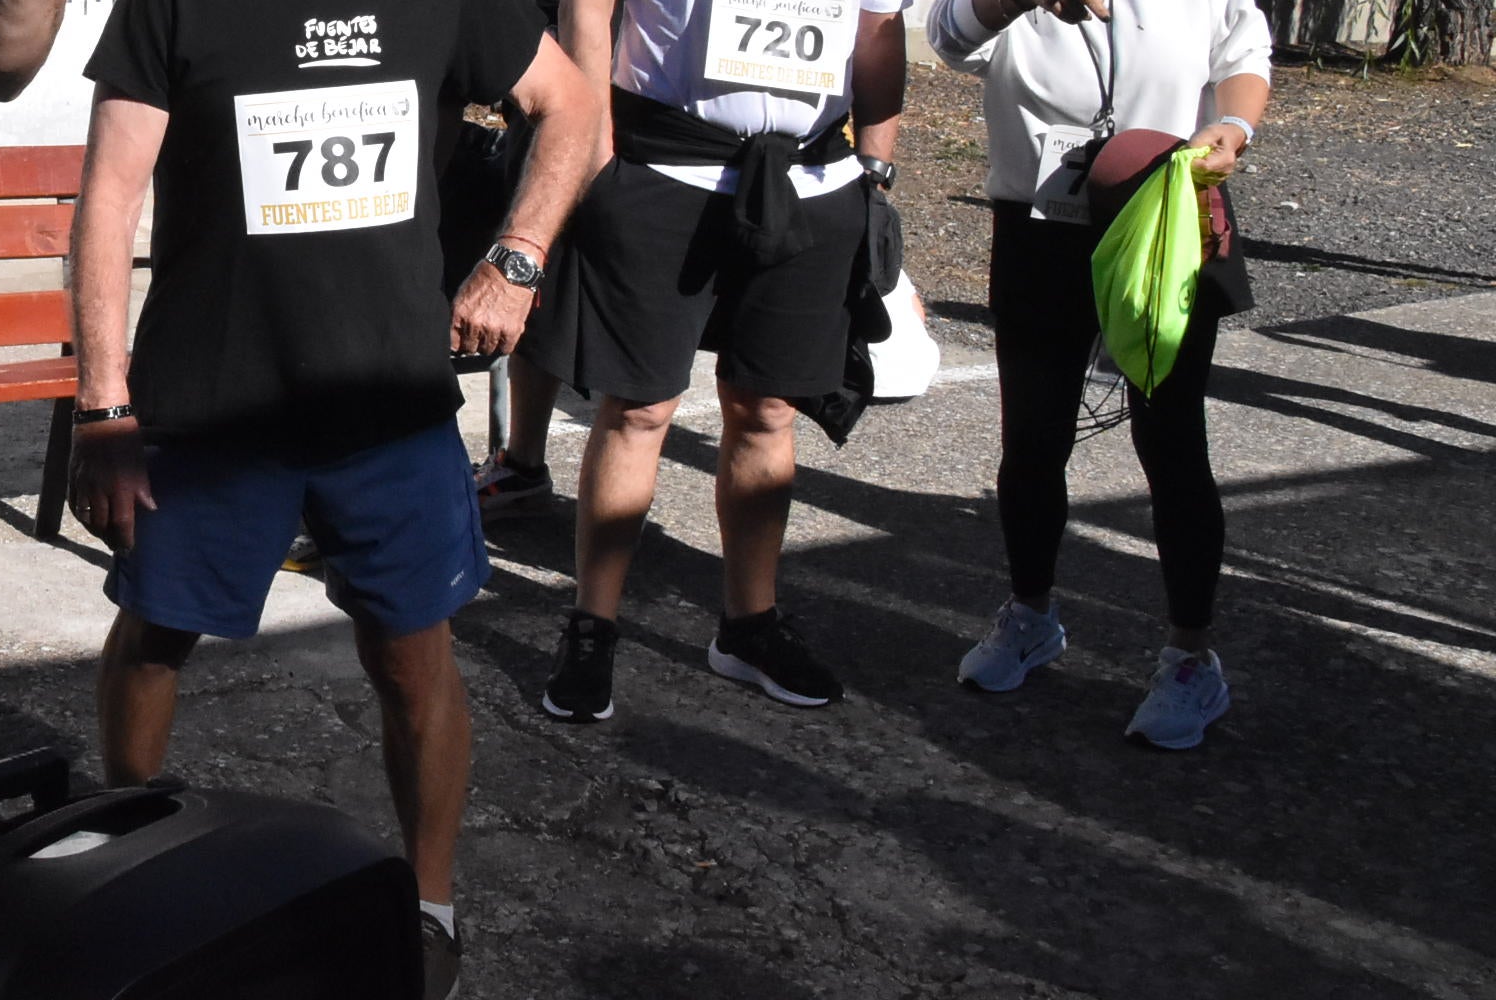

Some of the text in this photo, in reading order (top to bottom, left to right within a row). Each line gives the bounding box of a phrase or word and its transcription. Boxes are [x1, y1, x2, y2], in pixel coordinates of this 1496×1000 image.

[304, 15, 377, 39] FUENTES
[734, 15, 824, 62] 720
[295, 36, 382, 58] DE BÉJAR
[719, 58, 774, 81] FUENTES
[247, 105, 315, 131] marcha
[273, 131, 396, 191] 787
[260, 191, 410, 227] FUENTES DE BÉJAR
